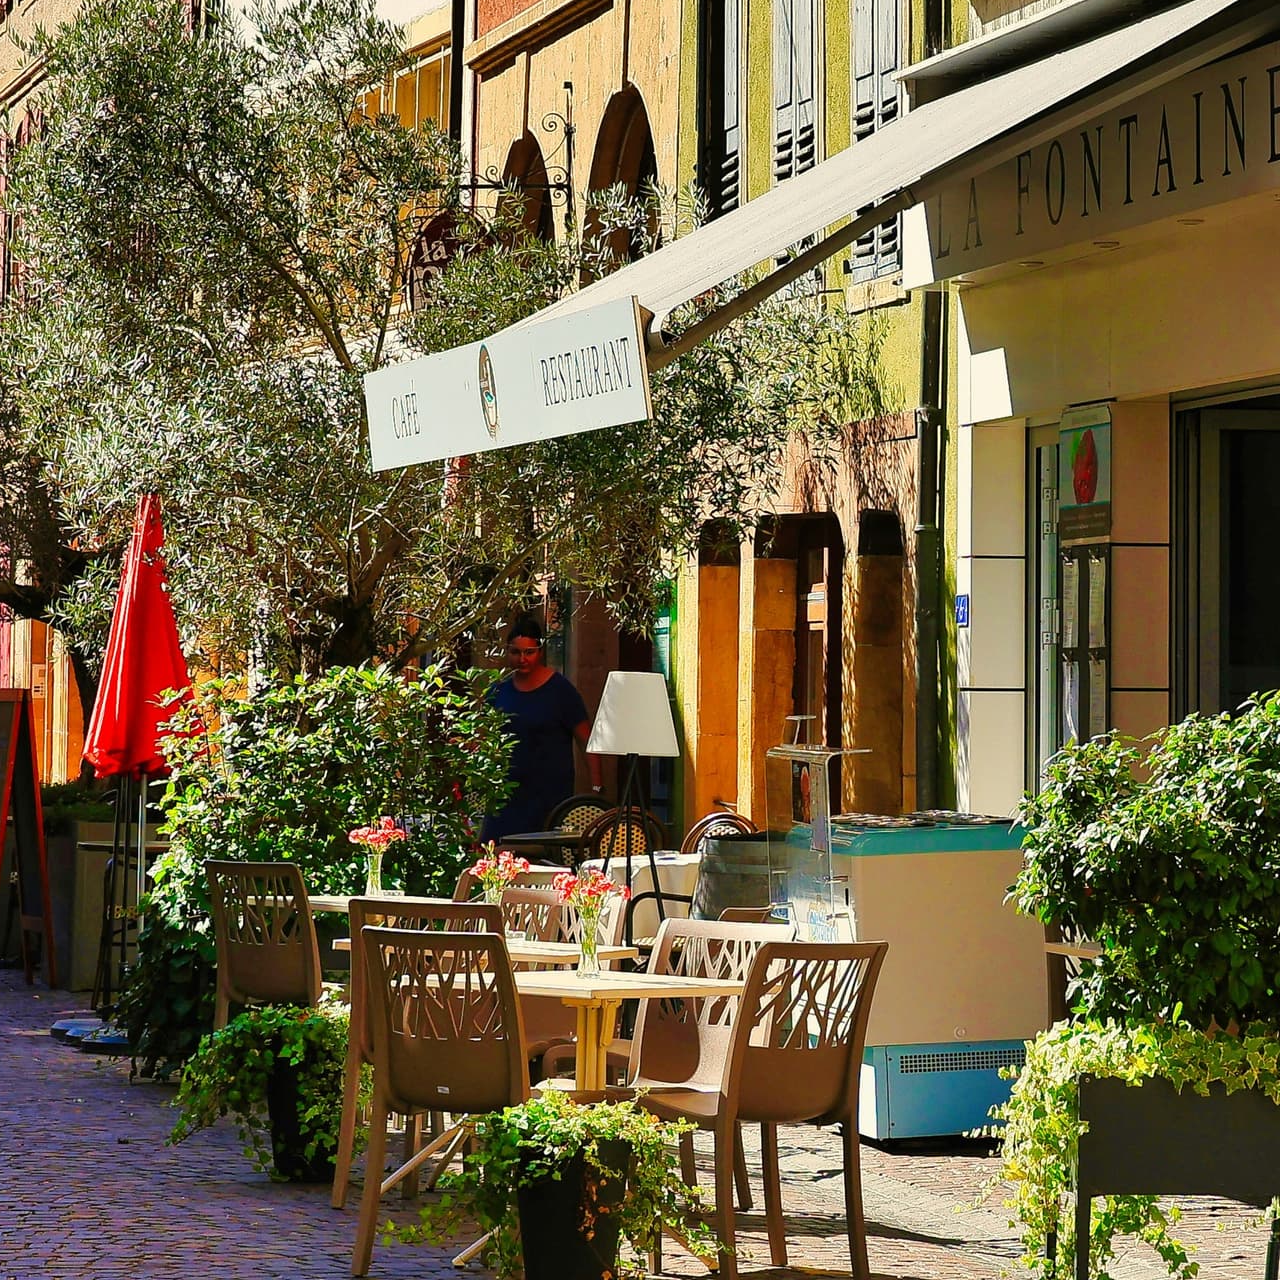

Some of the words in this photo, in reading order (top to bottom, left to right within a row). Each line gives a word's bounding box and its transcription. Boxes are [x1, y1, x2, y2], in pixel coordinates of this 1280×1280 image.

[935, 177, 983, 259] LA
[391, 379, 422, 440] CAFÉ
[540, 336, 633, 407] RESTAURANT
